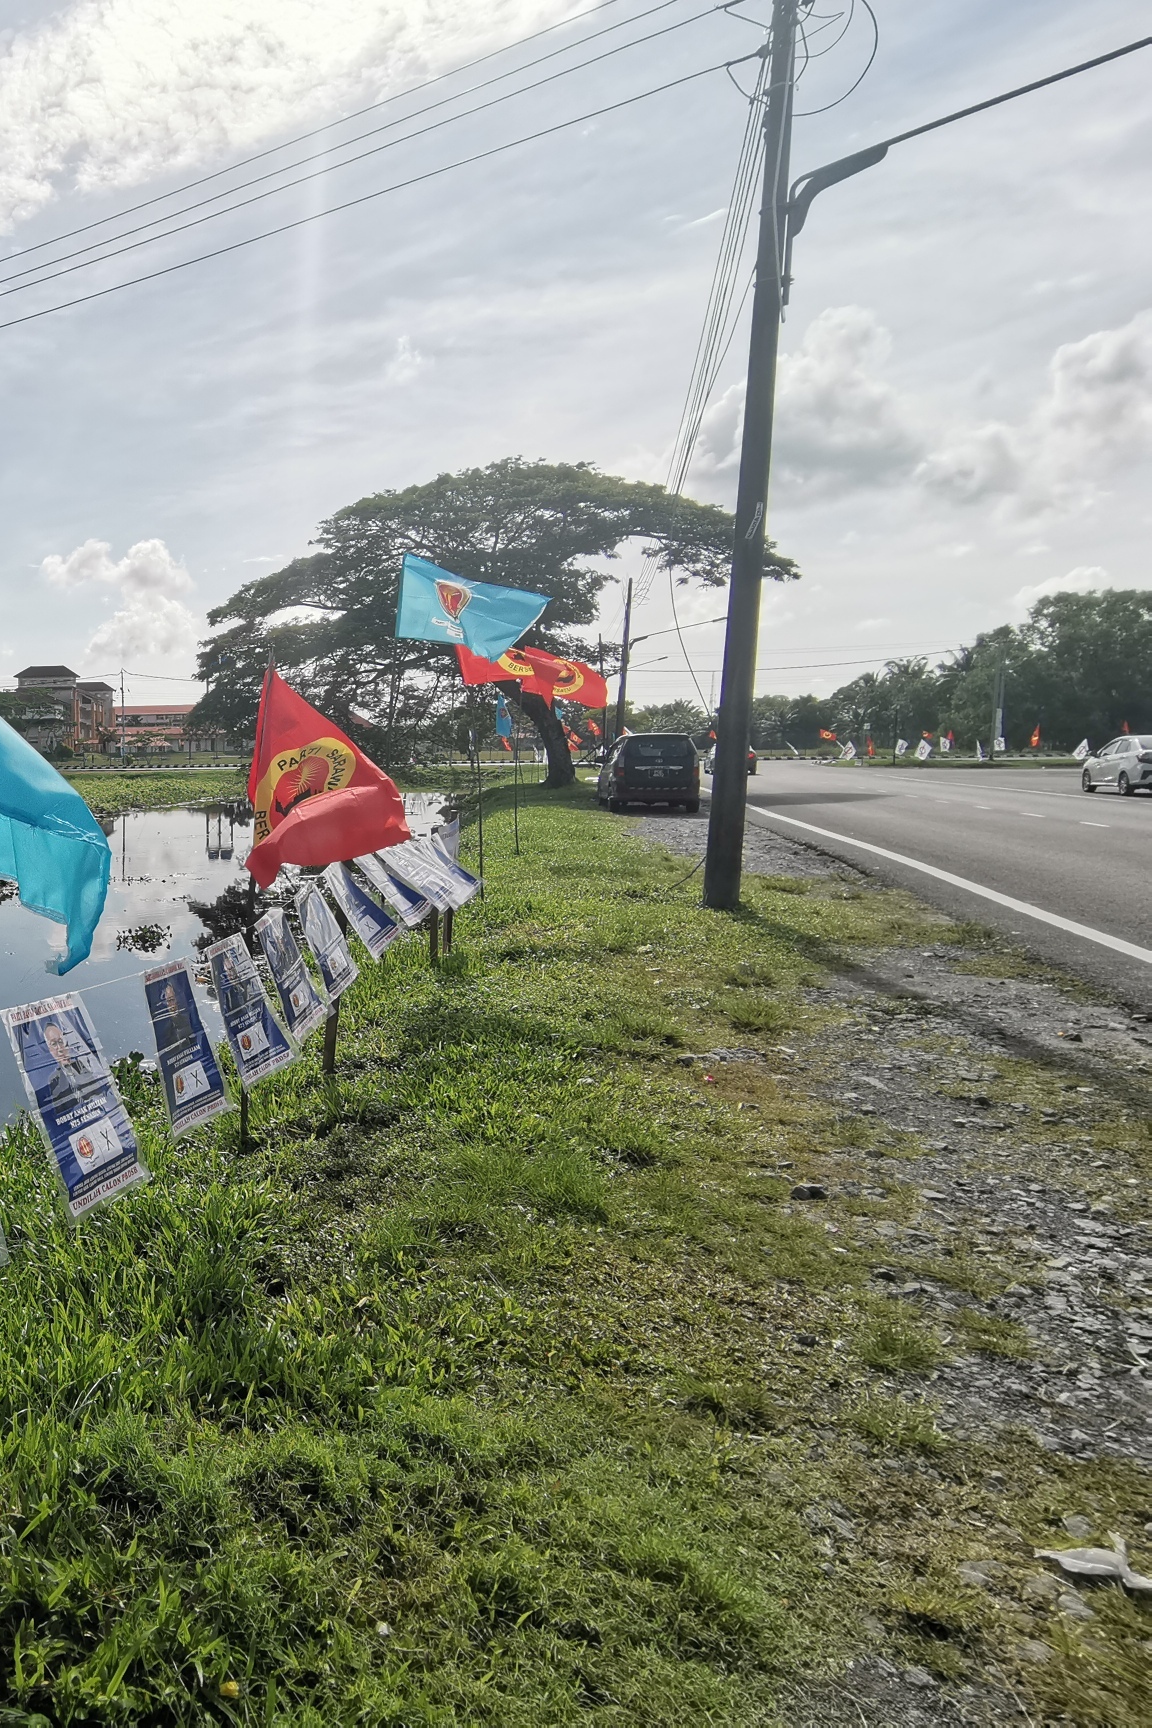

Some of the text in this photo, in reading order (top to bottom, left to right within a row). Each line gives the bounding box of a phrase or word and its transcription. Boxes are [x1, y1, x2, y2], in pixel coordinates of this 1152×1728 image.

[277, 746, 322, 772] PARTI
[326, 748, 346, 791] SARAW
[254, 810, 270, 840] BER
[101, 1177, 122, 1193] CALON
